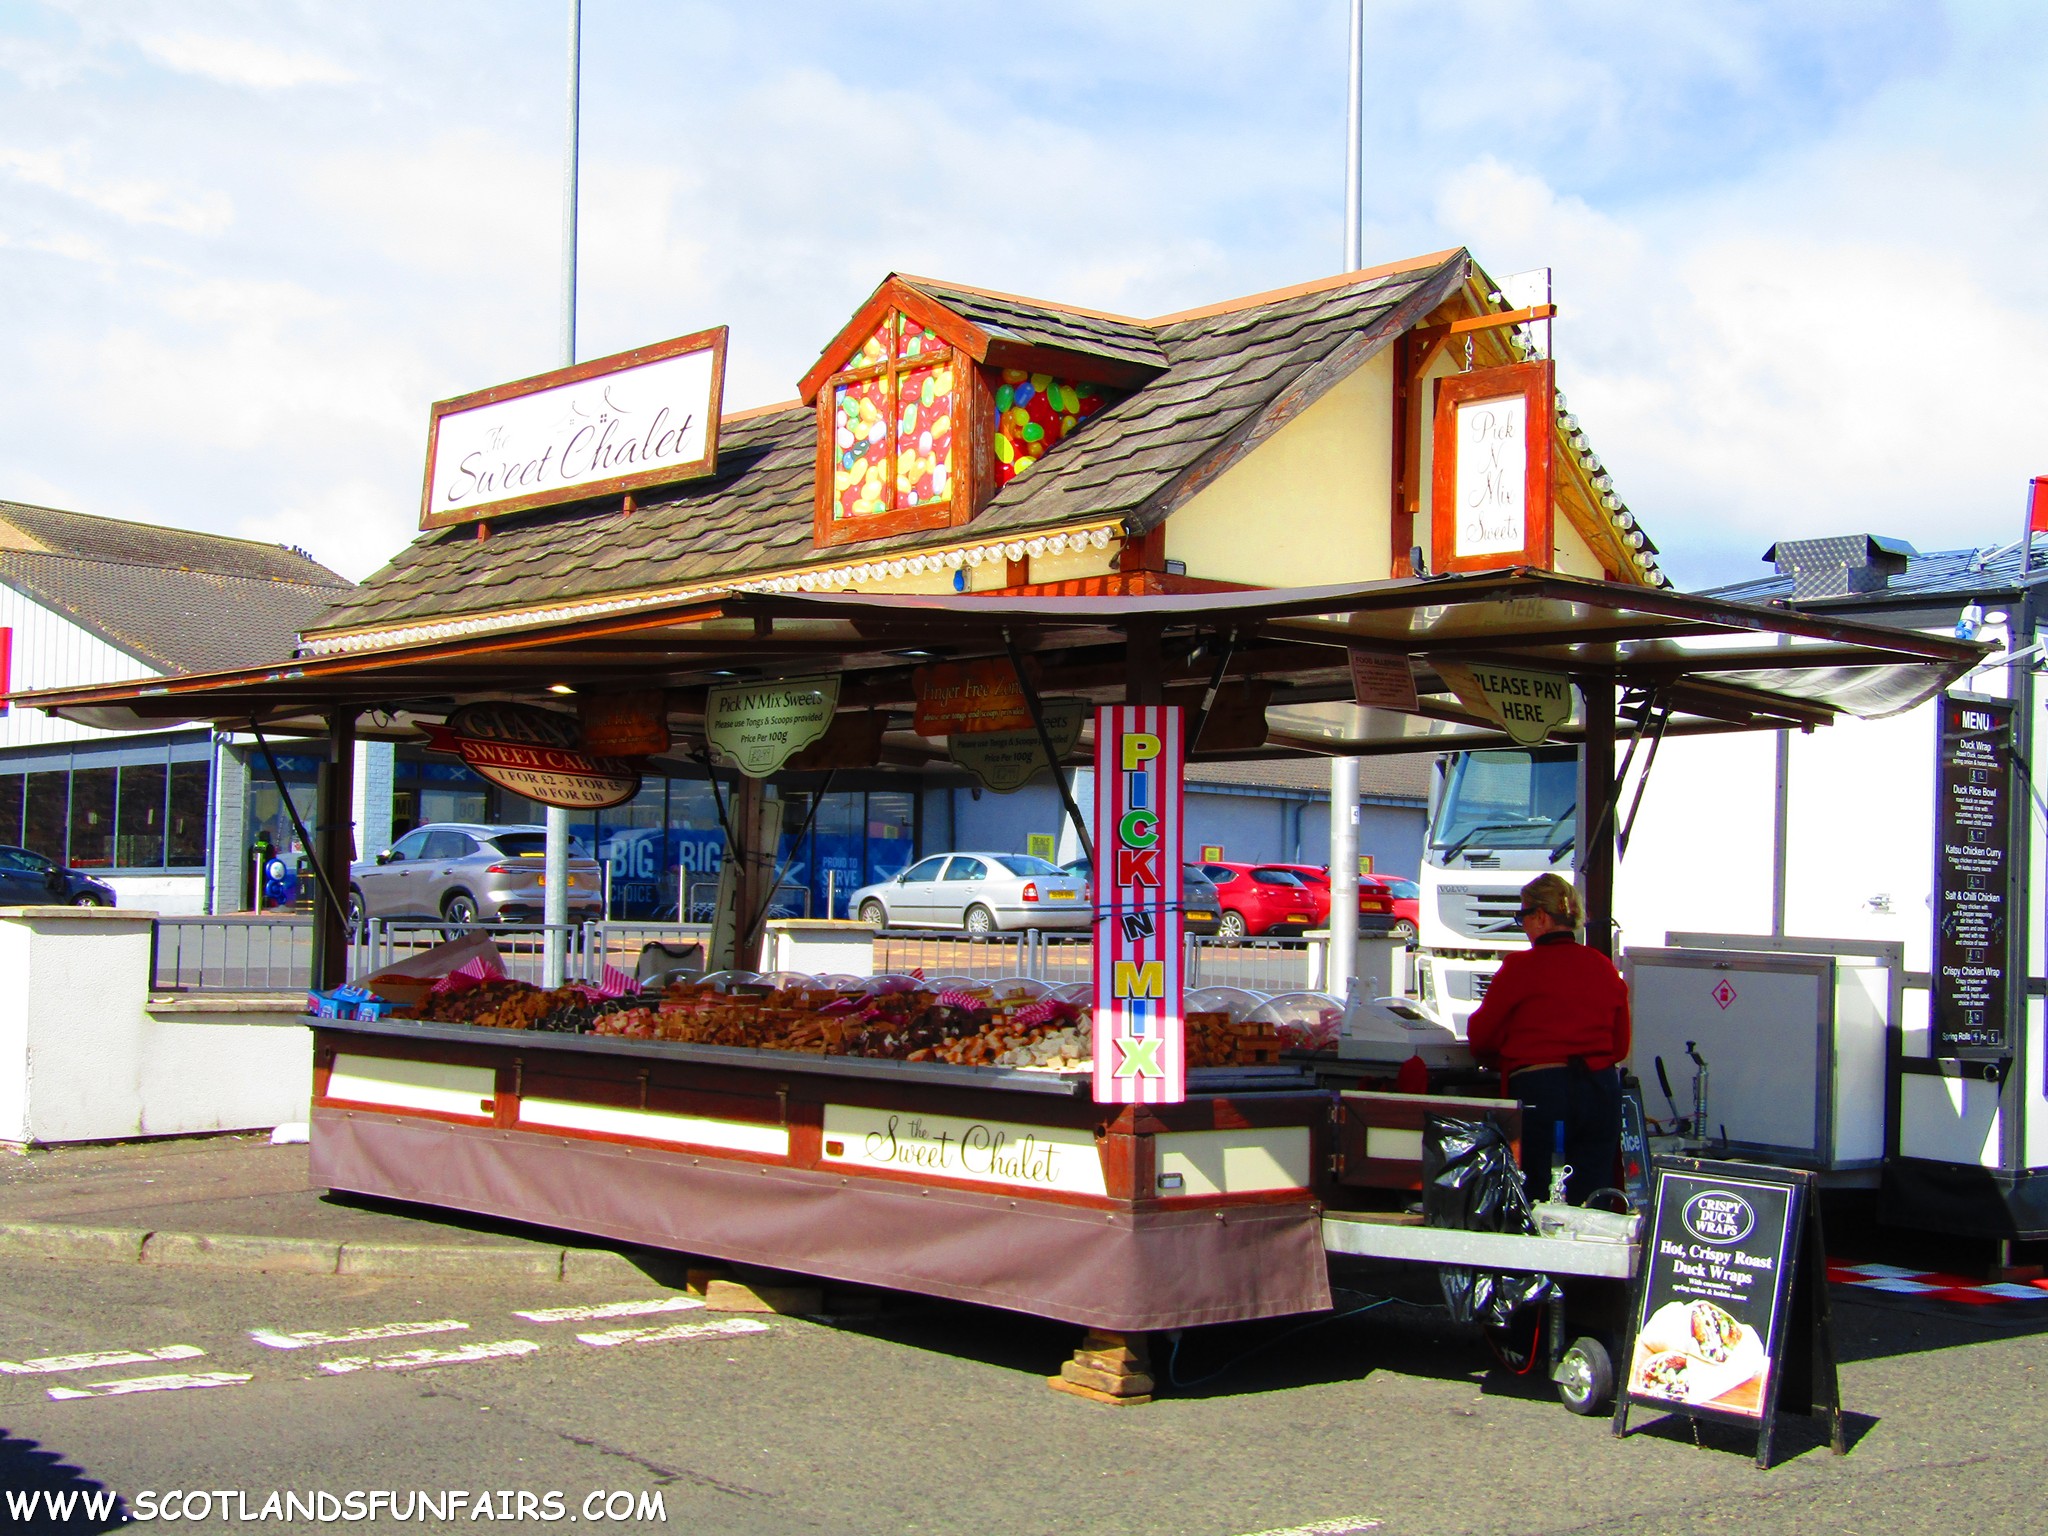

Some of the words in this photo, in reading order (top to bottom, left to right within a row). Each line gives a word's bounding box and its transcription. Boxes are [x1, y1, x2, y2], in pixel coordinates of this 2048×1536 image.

[1471, 410, 1515, 443] Pick
[447, 445, 553, 502] Sweet
[560, 407, 692, 479] Chalet
[1478, 441, 1504, 474] N
[1468, 468, 1515, 508] Mix
[1466, 510, 1518, 543] Sweets
[923, 682, 960, 707] Finger
[965, 680, 990, 698] Free
[1534, 680, 1562, 700] PAY
[719, 696, 741, 713] Pick
[744, 695, 756, 711] N
[757, 693, 781, 710] Mix
[783, 691, 822, 708] Sweets
[1502, 701, 1545, 723] HERE
[715, 720, 733, 729] Please
[746, 718, 764, 728] Tongs
[764, 717, 770, 725] &
[771, 716, 793, 726] Scoops
[793, 713, 823, 725] provided
[1043, 715, 1067, 727] eets
[1962, 710, 1989, 730] MENU
[740, 734, 756, 743] Price
[757, 734, 767, 742] Per
[769, 731, 788, 744] 100g
[1960, 739, 1975, 750] Duck
[1976, 741, 1991, 753] Wrap
[461, 742, 545, 766] SWEET
[984, 754, 1000, 763] Price
[1013, 752, 1033, 763] 100g
[498, 770, 505, 780] 1
[509, 771, 538, 785] FOR
[541, 775, 556, 786] £2
[567, 777, 574, 787] 3
[575, 778, 606, 791] FOR
[1953, 784, 1968, 795] Duck
[1969, 785, 1982, 796] Rice
[1983, 787, 1997, 797] Bowl
[532, 786, 547, 797] 10
[549, 787, 579, 800] FOR
[582, 791, 604, 803] £10
[1117, 732, 1162, 887] PICK
[611, 839, 654, 878] BIG
[679, 840, 721, 872] BIG
[1945, 844, 1961, 854] Katsu
[1962, 845, 1985, 856] Chicken
[1986, 847, 2001, 859] Curry
[822, 857, 847, 868] PROUD
[849, 857, 858, 869] TO
[822, 869, 858, 887] SRVE
[611, 885, 653, 901] CHOICE
[1439, 885, 1469, 893] VOLVO
[1945, 890, 1956, 900] Salt
[1957, 891, 1962, 900] &
[1962, 891, 1977, 901] Chilli
[1977, 892, 2000, 902] Chicken
[1121, 909, 1156, 943] N
[1942, 965, 1960, 977] Crispy
[1962, 966, 1984, 976] Chicken
[1985, 967, 2000, 978] Wrap
[1113, 960, 1165, 1079] MIX
[1942, 1032, 1957, 1042] Spring
[1959, 1032, 1970, 1041] Rolls
[907, 1117, 929, 1140] the
[862, 1114, 954, 1169] Sweet
[960, 1124, 1061, 1183] Chalet
[1697, 1198, 1742, 1214] CRISPY
[1700, 1209, 1736, 1224] DUCK
[1696, 1220, 1738, 1236] WRAPS
[1660, 1240, 1686, 1258] Hot,
[1689, 1244, 1732, 1265] Crispy
[1734, 1250, 1773, 1269] Roast
[1673, 1259, 1706, 1277] Duck
[1710, 1264, 1753, 1286] Wraps
